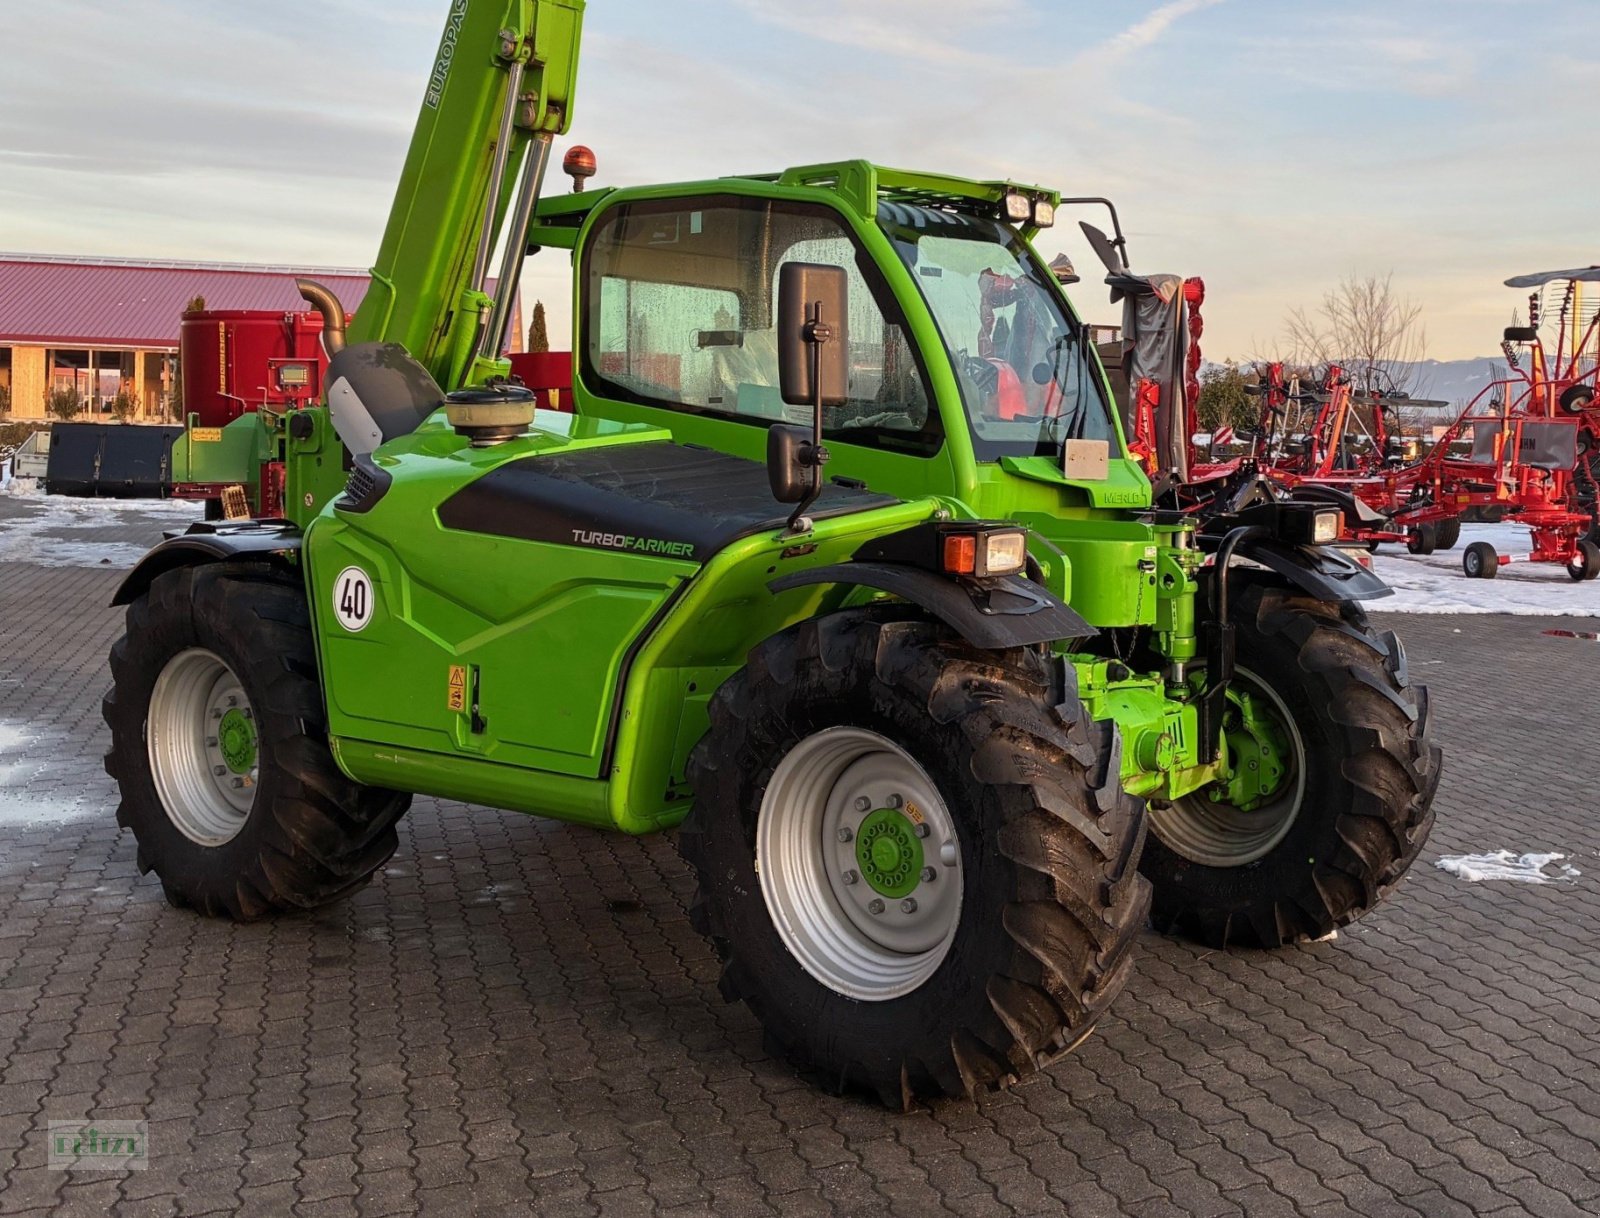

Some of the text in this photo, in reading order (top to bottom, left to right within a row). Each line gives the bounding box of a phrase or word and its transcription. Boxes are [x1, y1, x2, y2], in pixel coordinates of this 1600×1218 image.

[1104, 491, 1141, 504] MERLO
[572, 529, 694, 557] TURBOFARMER
[341, 578, 366, 620] 40
